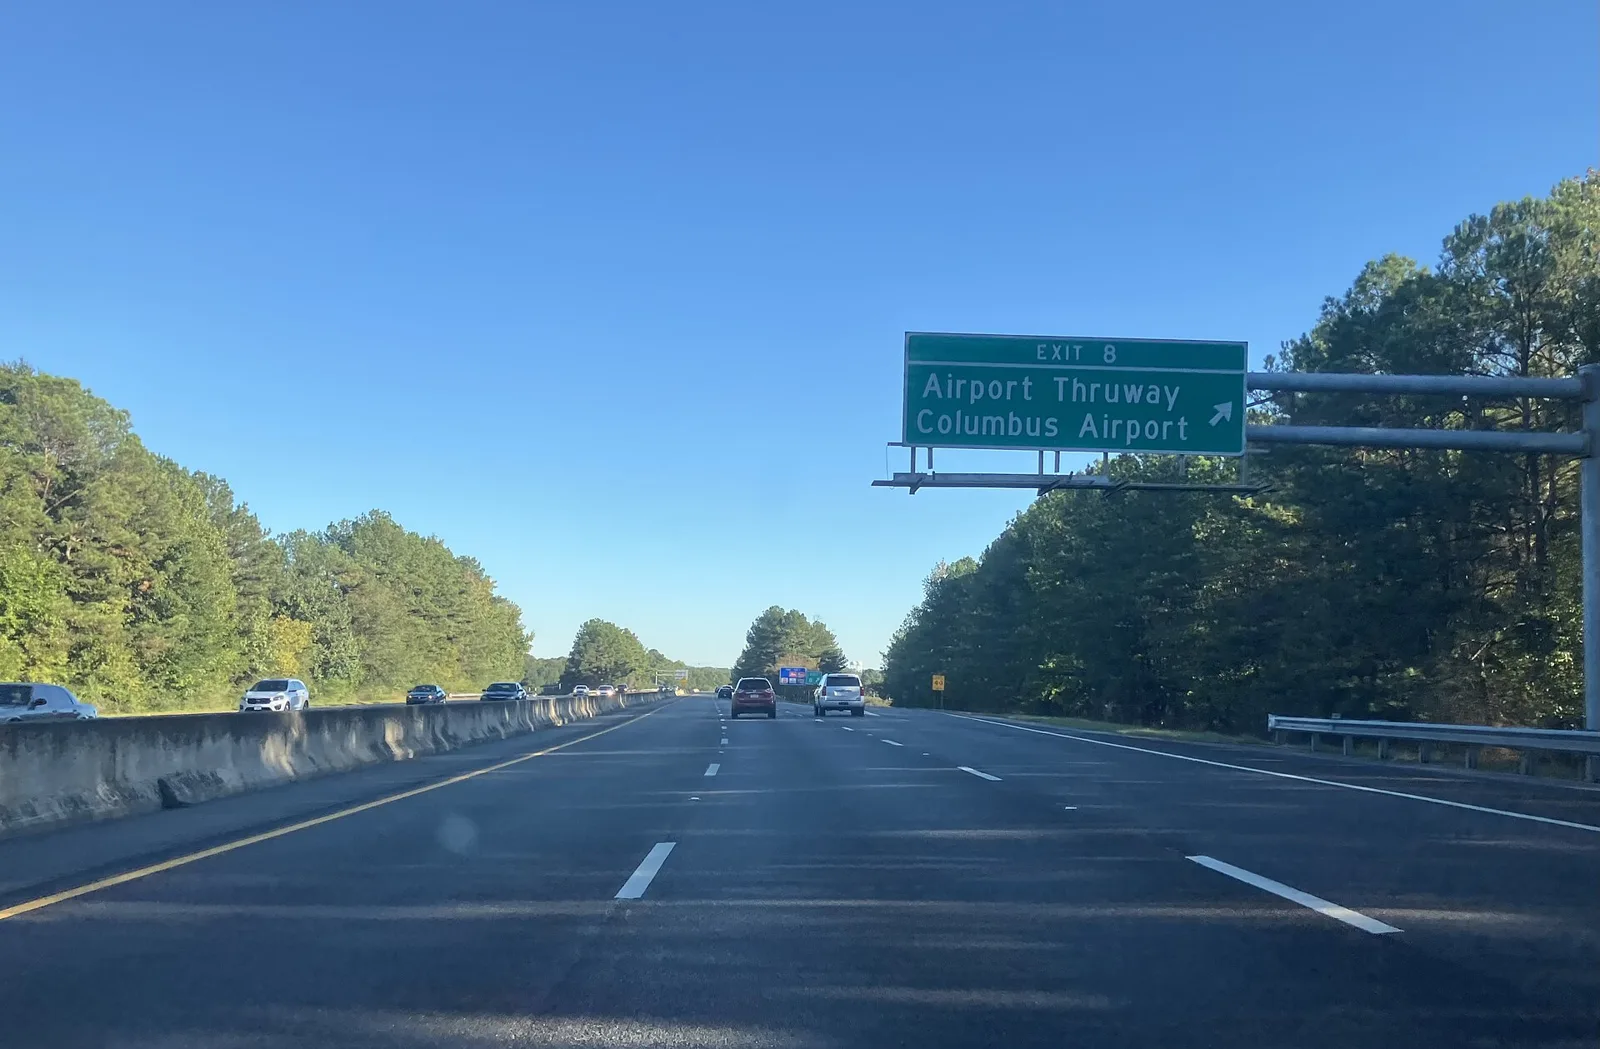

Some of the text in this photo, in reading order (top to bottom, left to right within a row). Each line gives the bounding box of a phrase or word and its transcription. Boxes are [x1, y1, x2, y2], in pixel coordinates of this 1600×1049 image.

[1036, 344, 1117, 364] EXIT 8
[922, 373, 1180, 412] Airport Thruway
[916, 408, 1188, 446] Columbus Airport
